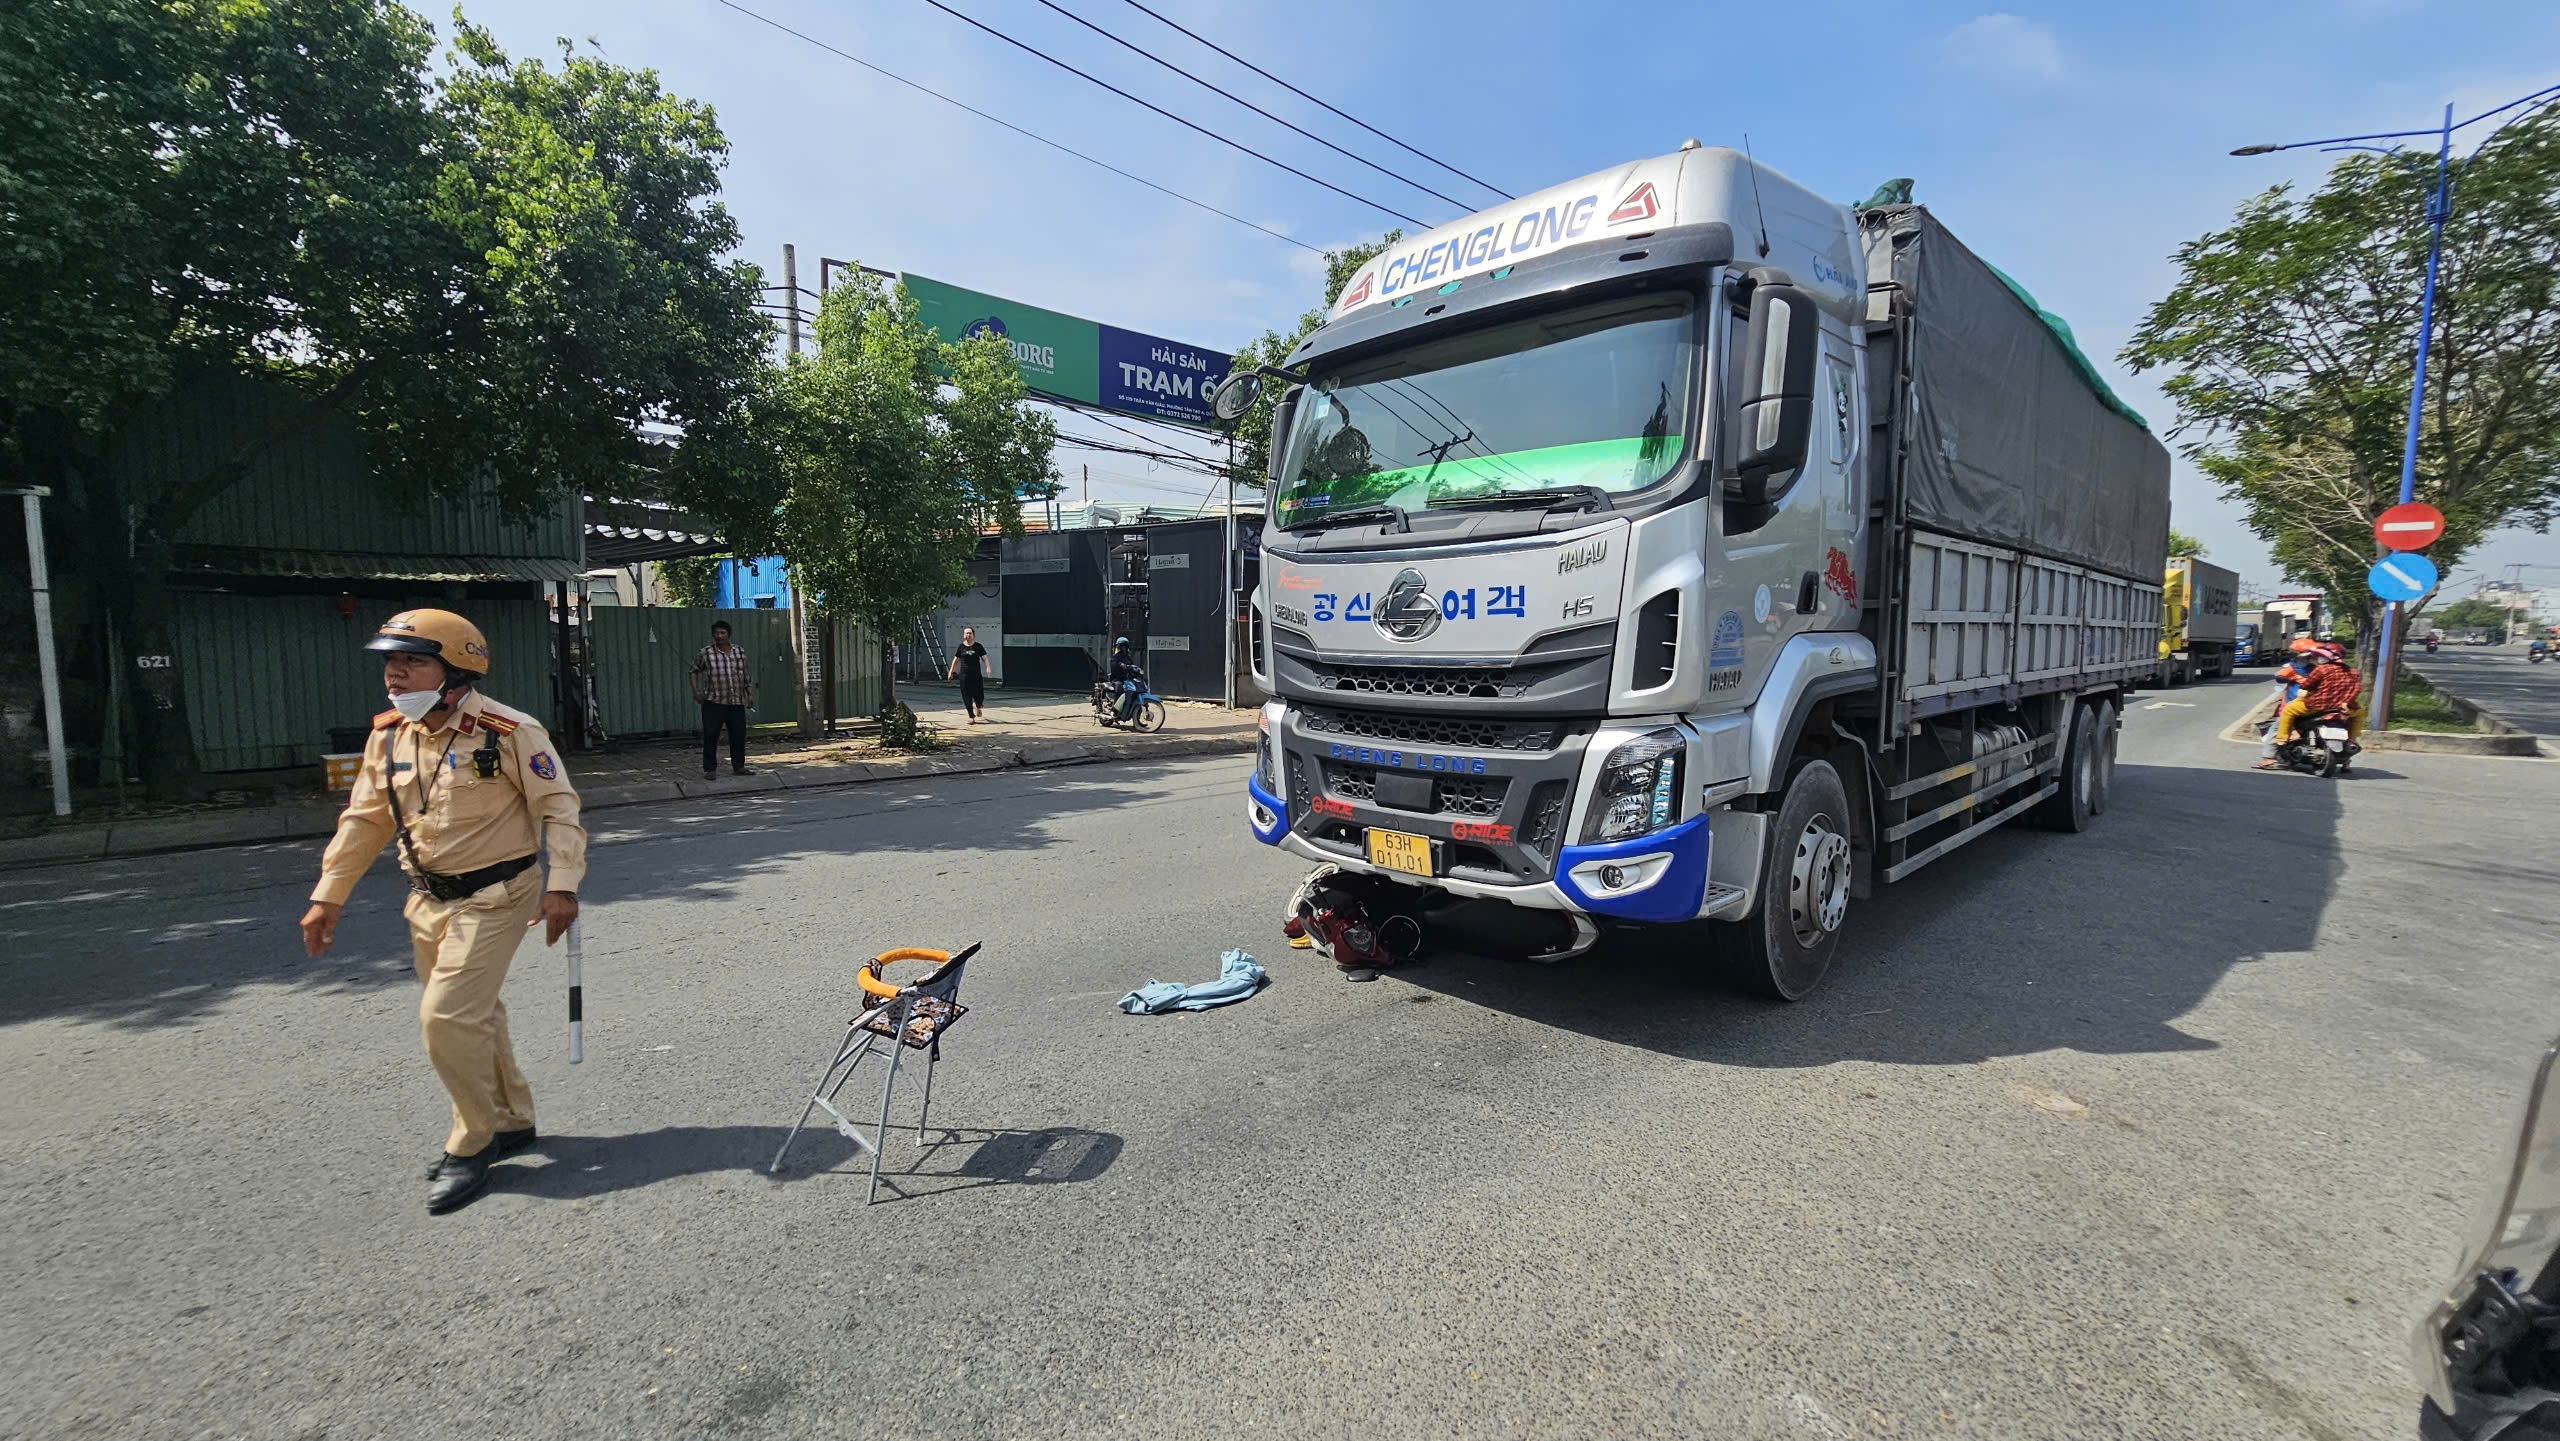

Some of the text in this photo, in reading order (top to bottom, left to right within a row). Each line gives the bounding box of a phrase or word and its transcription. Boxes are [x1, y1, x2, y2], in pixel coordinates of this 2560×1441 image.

[1381, 195, 1598, 295] CHENGLONG
[1151, 346, 1207, 372] HẢI SẢN
[1119, 361, 1193, 400] TRẠM
[1313, 585, 1525, 622] 광신 여객
[137, 655, 170, 668] 621
[1330, 743, 1486, 774] CHENG LONG
[1385, 833, 1412, 852] 63H
[1377, 849, 1423, 873] 011.01
